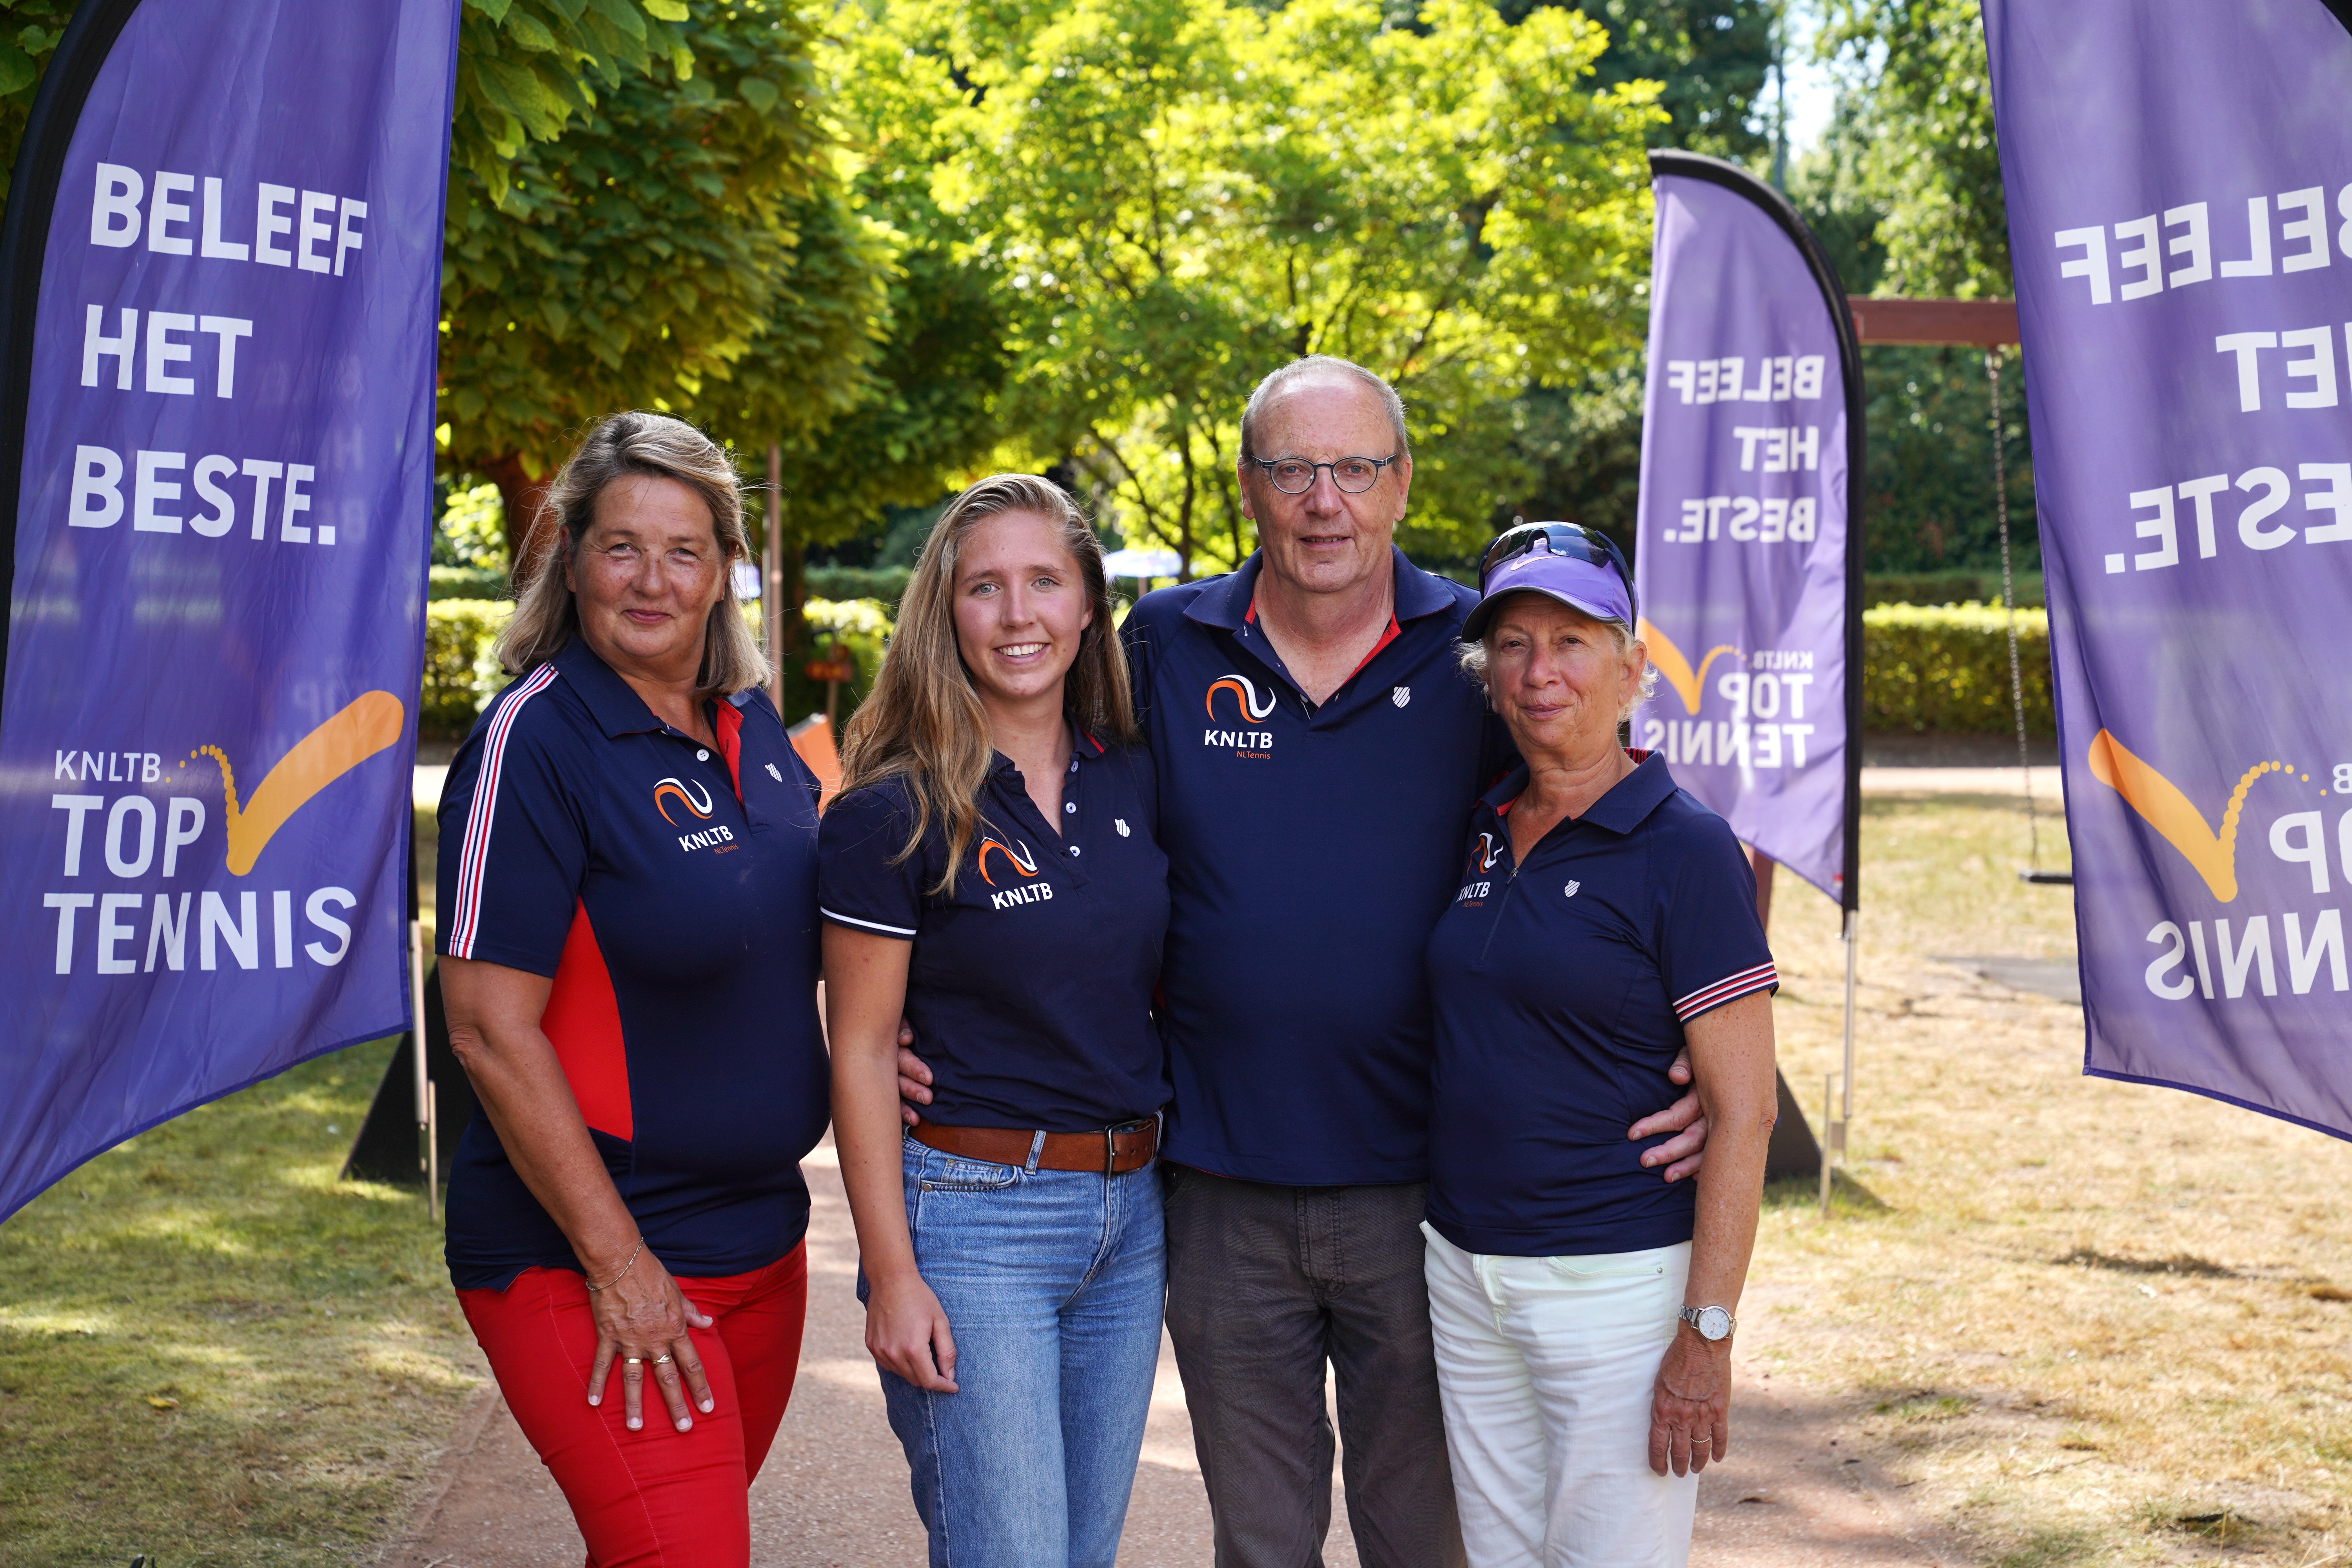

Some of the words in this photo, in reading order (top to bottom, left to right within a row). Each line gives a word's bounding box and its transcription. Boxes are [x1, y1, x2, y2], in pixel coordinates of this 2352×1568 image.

[91, 162, 368, 276] BELEEF
[81, 304, 253, 399] HET
[68, 445, 335, 545] BESTE.
[1205, 730, 1272, 749] KNLTB
[54, 750, 161, 783] KNLTB
[1236, 751, 1270, 759] NLTennis
[51, 794, 205, 878] TOP
[678, 826, 733, 852] KNLTB
[714, 843, 739, 854] NLTennis
[991, 882, 1053, 910] KNLTB
[1455, 882, 1490, 903] KNLTB
[44, 886, 357, 975] TENNIS
